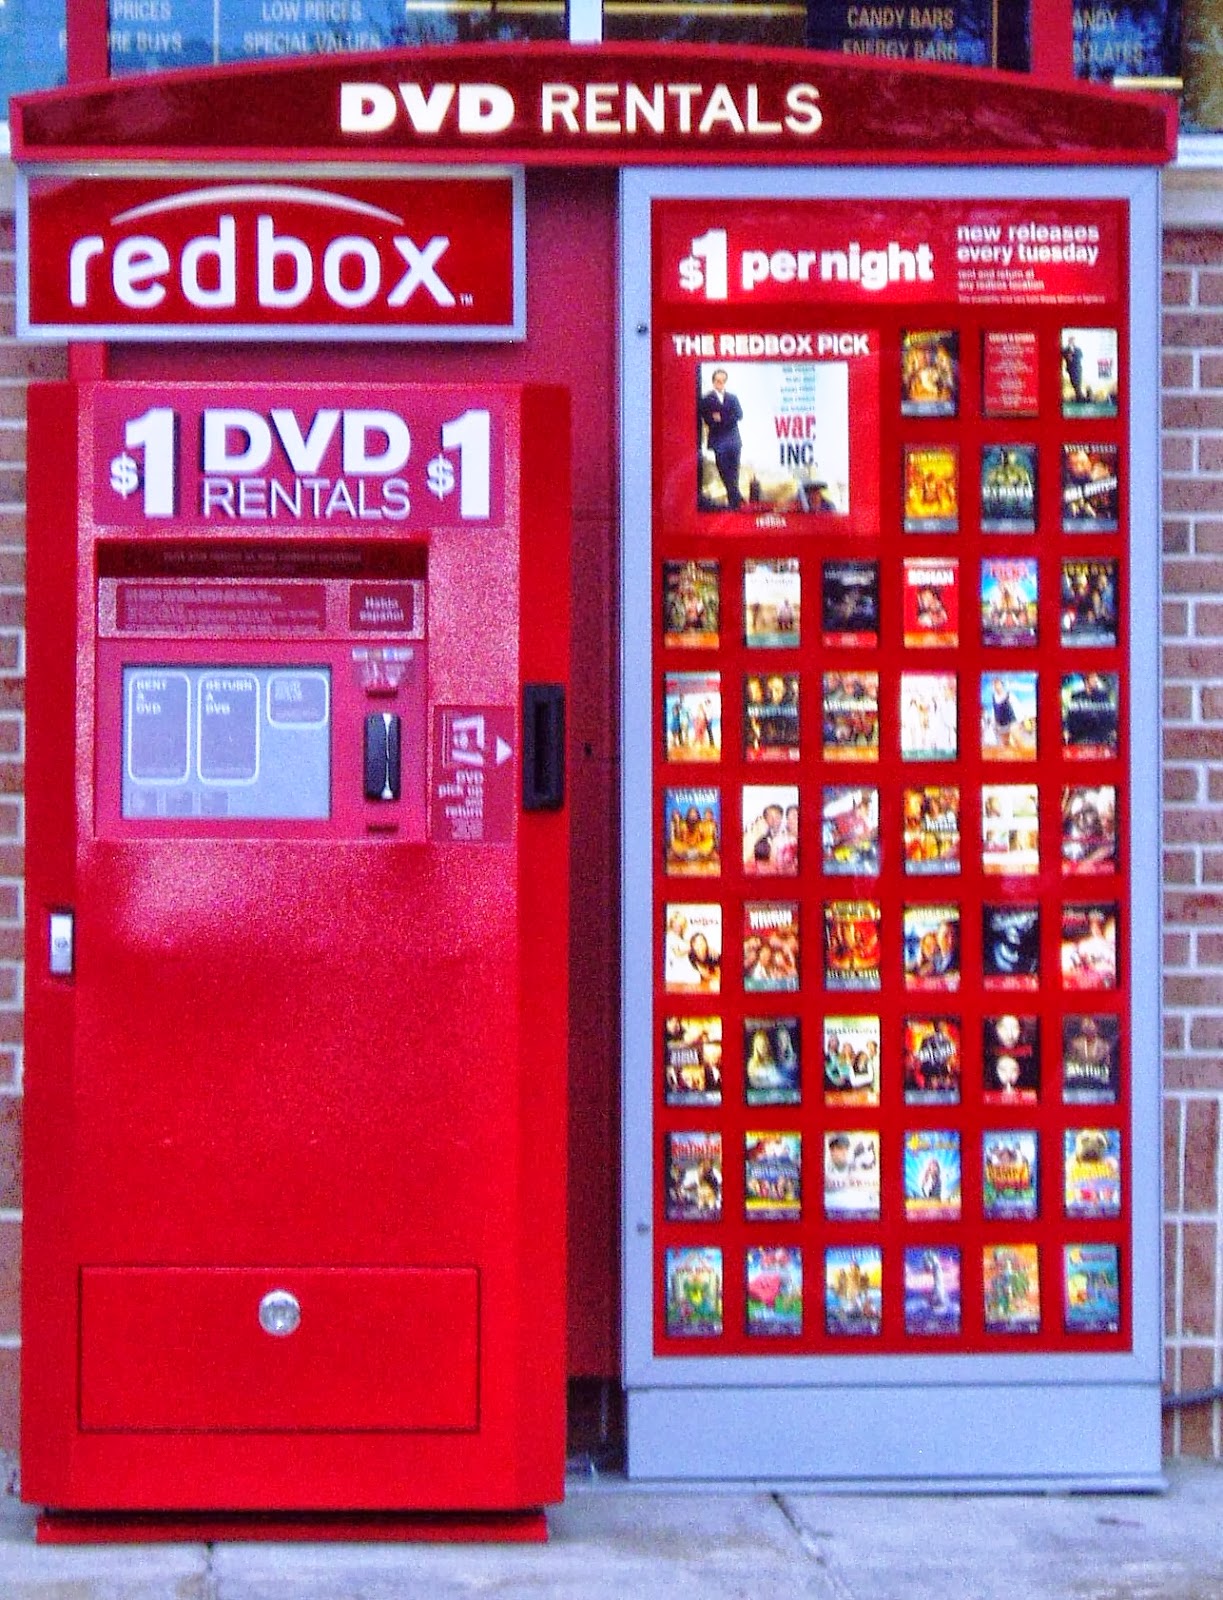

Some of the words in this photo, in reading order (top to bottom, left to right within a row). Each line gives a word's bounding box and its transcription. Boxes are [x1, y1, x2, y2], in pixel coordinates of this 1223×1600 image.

[113, 0, 171, 21] PRICES
[262, 1, 300, 22] LOW
[847, 5, 905, 29] CANDY
[910, 6, 954, 30] BARS
[1072, 8, 1117, 31] ANDY
[136, 31, 182, 52] BUYS
[243, 30, 307, 53] SPECIAL
[340, 83, 516, 135] DVD
[541, 82, 824, 136] RENTALS
[957, 225, 1002, 243] new
[1008, 221, 1100, 243] releases
[69, 214, 457, 309] redbox
[678, 227, 728, 300] $1
[742, 249, 817, 291] per
[819, 240, 934, 291] night
[957, 244, 1013, 267] every
[1018, 242, 1099, 267] tuesday
[672, 333, 716, 356] THE
[719, 333, 813, 356] REDBOX
[817, 332, 870, 356] PICK
[203, 407, 412, 476] DVD
[109, 406, 179, 519] $1
[426, 408, 491, 519] $1
[203, 477, 412, 520] RENTALS
